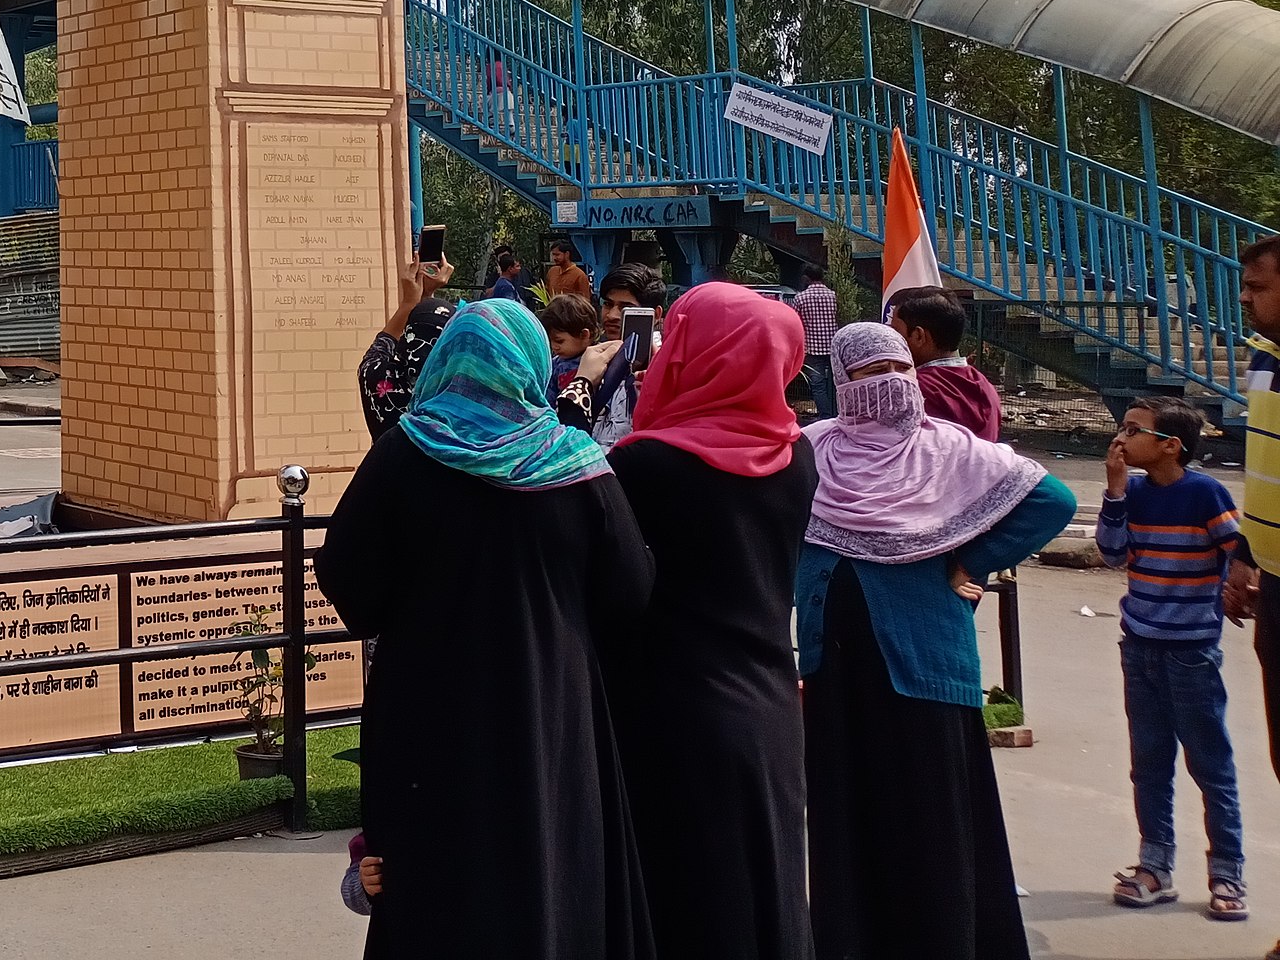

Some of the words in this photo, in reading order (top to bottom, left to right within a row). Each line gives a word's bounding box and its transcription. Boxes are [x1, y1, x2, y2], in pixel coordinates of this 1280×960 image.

[620, 206, 655, 224] NRC
[663, 200, 699, 223] CAA
[272, 274, 283, 283] MD
[285, 274, 306, 283] ANAS
[321, 274, 333, 283] MD
[334, 274, 357, 283] AASIF
[274, 295, 297, 305] ALEEM
[135, 575, 156, 587] We
[159, 574, 190, 585] have
[193, 570, 238, 582] always
[22, 589, 45, 609] जिन
[45, 583, 101, 610] क्रांतिकारियों
[101, 583, 111, 601] ने
[215, 587, 269, 599] between
[137, 611, 189, 628] politics,
[192, 606, 239, 622] gender.
[242, 603, 266, 615] The
[8, 620, 19, 639] में
[19, 618, 30, 640] ही
[32, 620, 69, 636] नक्काश
[70, 613, 92, 633] दिया
[137, 628, 196, 647] systemic
[318, 614, 338, 626] the
[137, 666, 189, 682] decided
[192, 665, 207, 676] to
[209, 661, 242, 675] meet
[6, 683, 21, 697] पर
[21, 677, 30, 696] ये
[32, 674, 62, 696] शाहीन
[63, 676, 83, 691] बाग
[85, 669, 99, 689] की
[138, 688, 174, 702] make
[177, 685, 187, 697] it
[190, 686, 198, 695] a
[202, 681, 239, 696] pulpit
[138, 708, 155, 721] all
